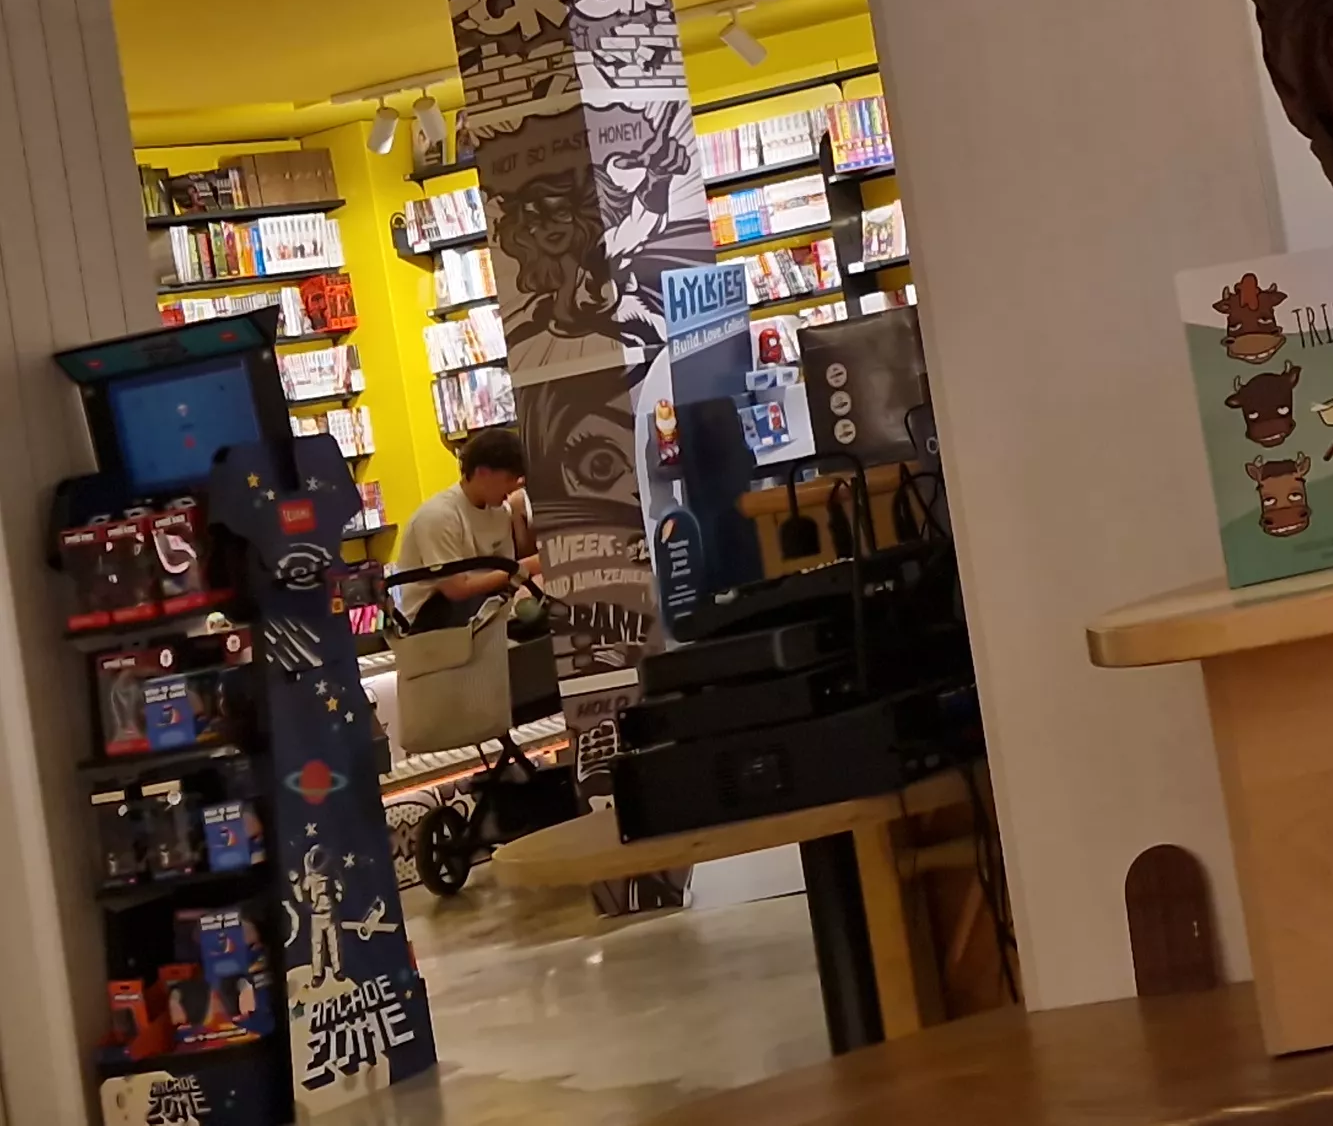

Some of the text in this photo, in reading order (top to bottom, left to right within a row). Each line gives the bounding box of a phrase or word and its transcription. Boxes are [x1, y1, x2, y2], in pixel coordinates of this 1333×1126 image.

[551, 129, 590, 154] FAST
[546, 532, 623, 567] WEEK:
[311, 974, 396, 1028] ARCADE
[303, 1002, 415, 1080] ZONE
[148, 1091, 212, 1124] ZONE
